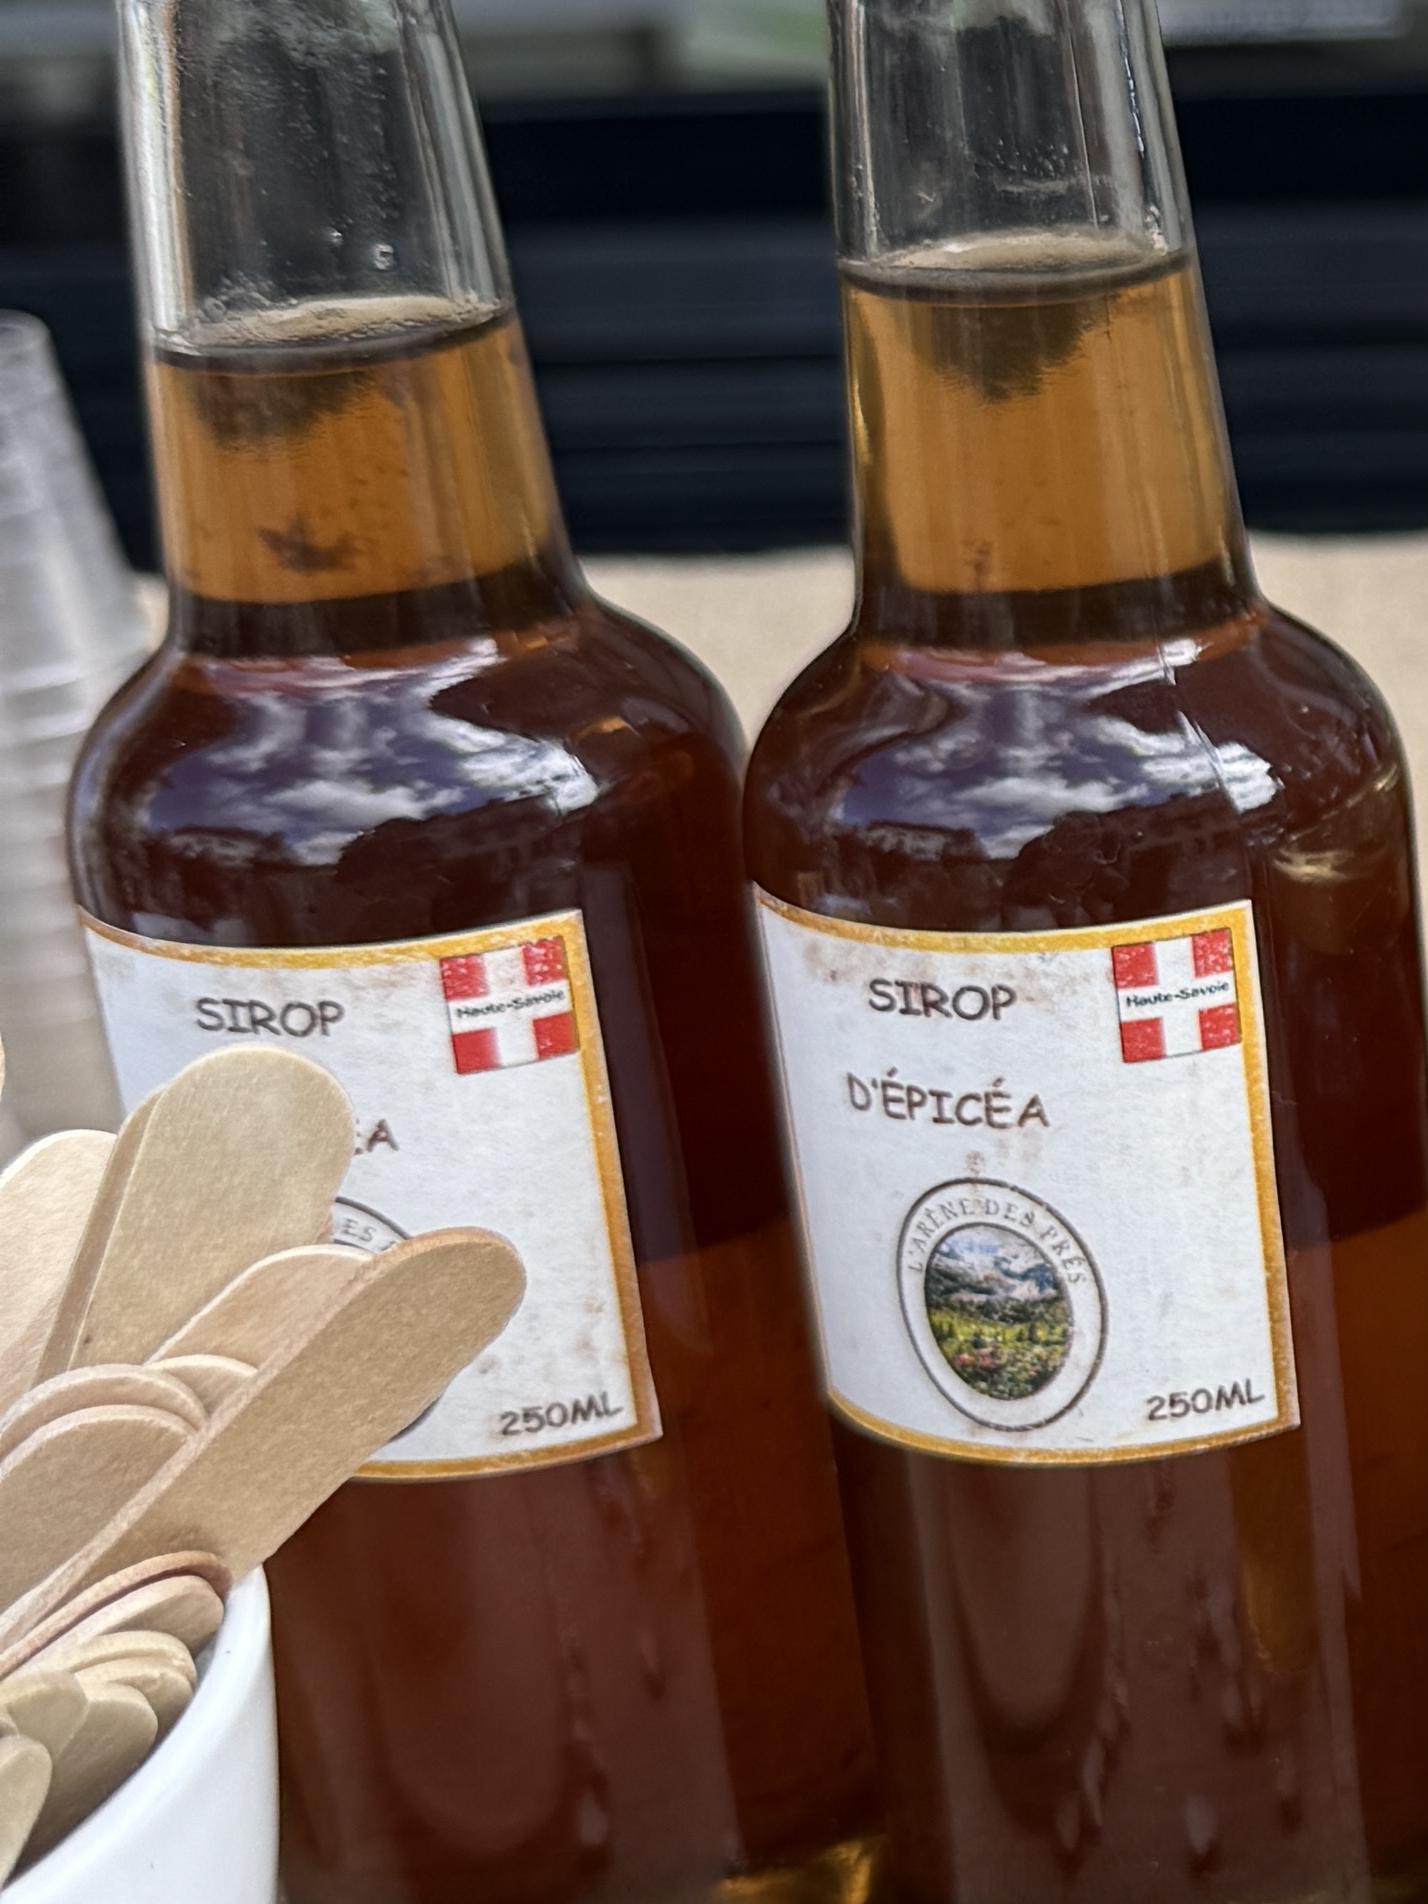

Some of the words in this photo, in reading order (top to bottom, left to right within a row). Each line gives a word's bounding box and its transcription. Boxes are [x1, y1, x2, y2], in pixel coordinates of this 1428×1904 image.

[868, 978, 1017, 1021] SIROP
[1126, 981, 1230, 1008] Haute-Savoie
[196, 997, 346, 1037] SIROP
[845, 1067, 1050, 1130] D'ÉPICÉA
[985, 1198, 1035, 1227] DES
[500, 1392, 623, 1437] 250ML
[1146, 1377, 1265, 1422] 250ML
